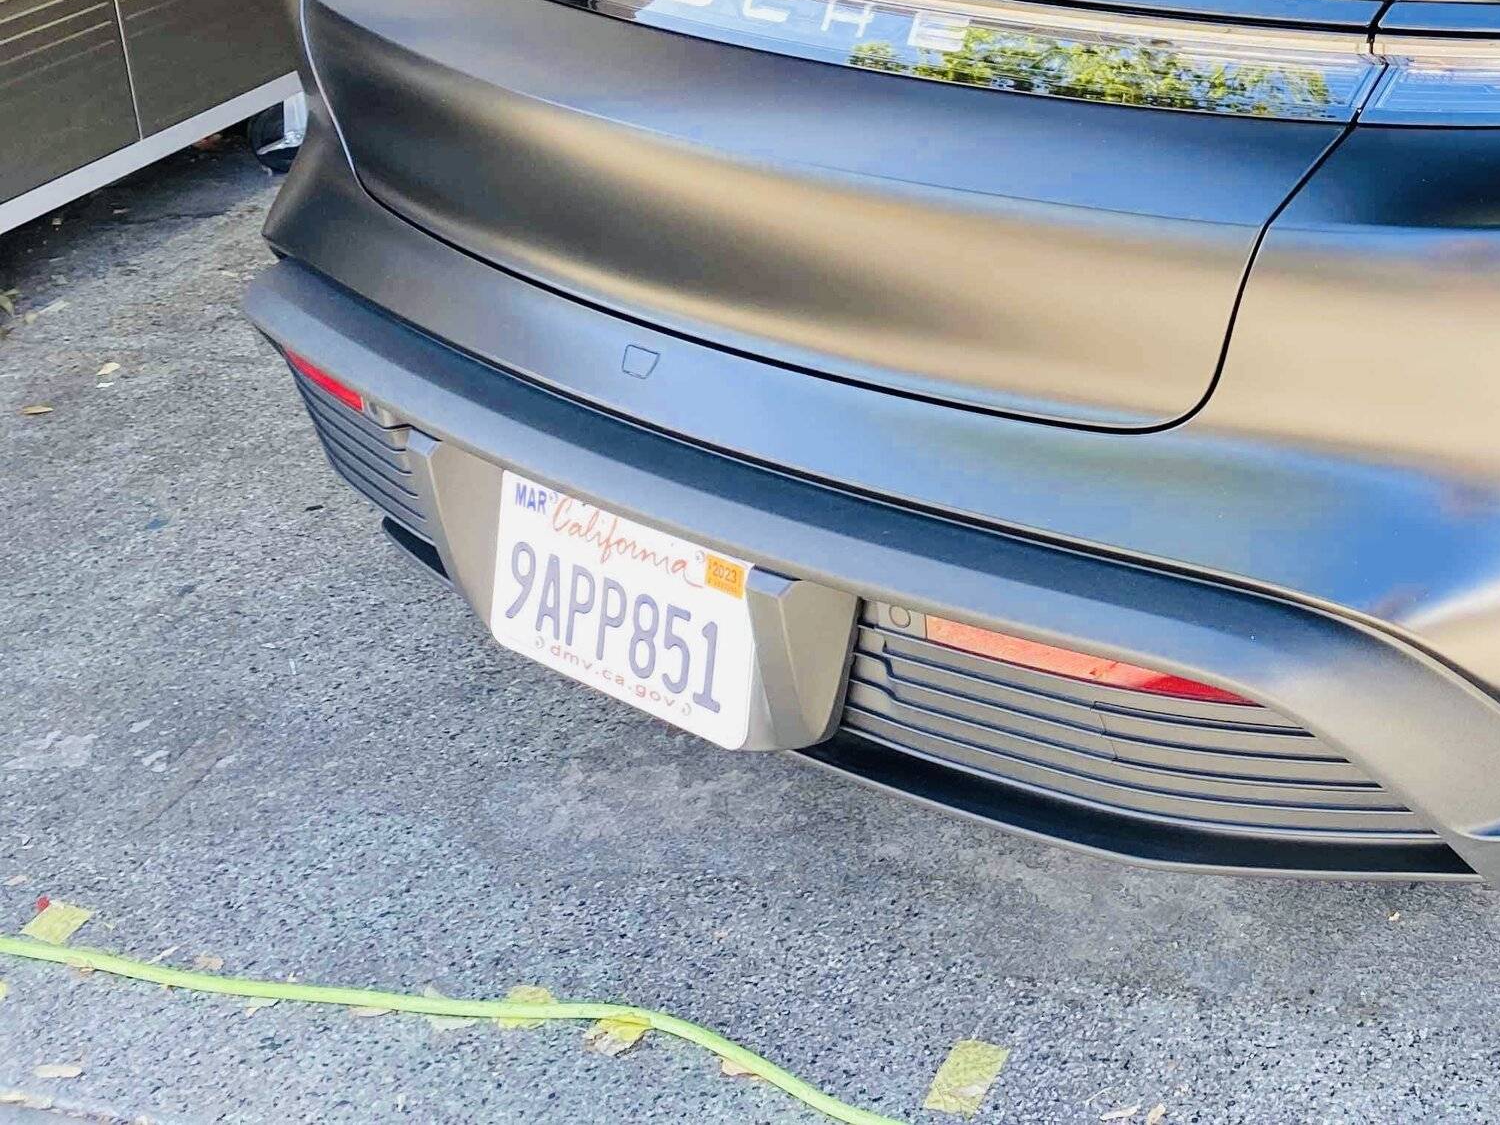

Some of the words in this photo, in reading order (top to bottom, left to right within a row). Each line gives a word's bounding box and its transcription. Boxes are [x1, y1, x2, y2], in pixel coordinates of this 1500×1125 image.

[514, 481, 549, 515] MAR
[550, 495, 705, 589] California
[711, 561, 738, 584] 2023
[504, 540, 722, 714] 9APP851
[549, 643, 676, 708] dmv.ca.gov
